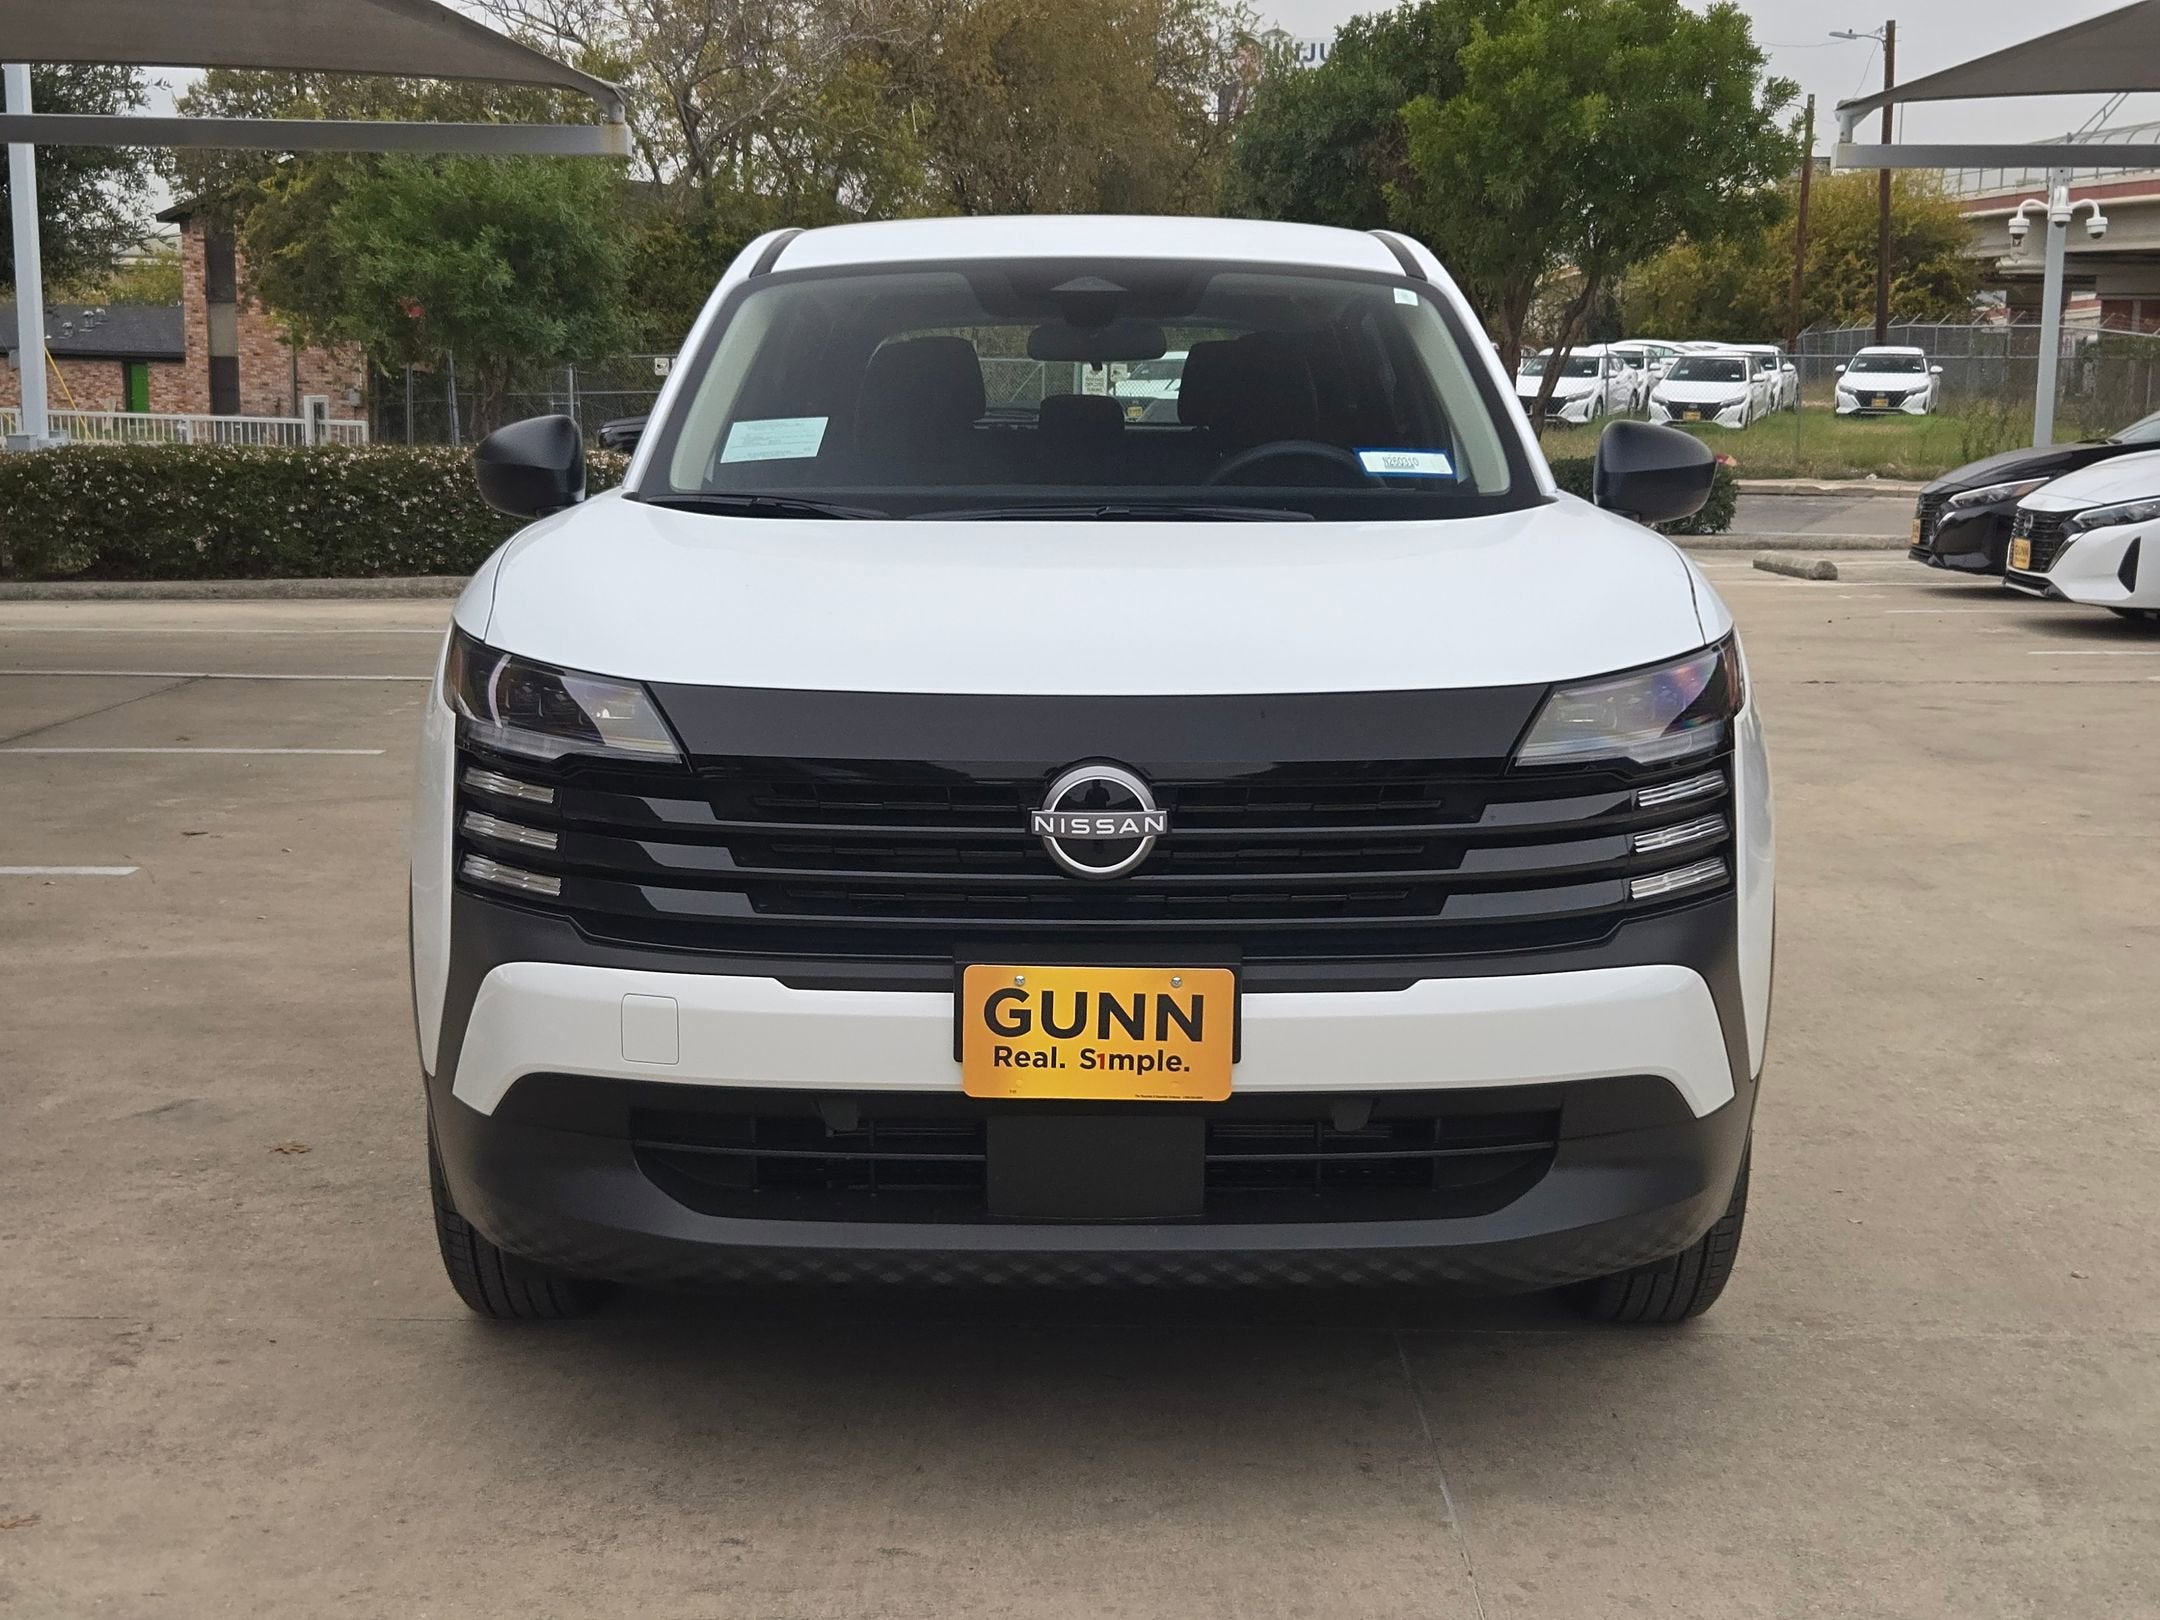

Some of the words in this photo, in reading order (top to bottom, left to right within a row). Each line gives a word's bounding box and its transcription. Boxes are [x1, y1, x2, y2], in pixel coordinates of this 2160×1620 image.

[1034, 815, 1164, 834] NISSAN
[983, 987, 1204, 1042] GUNN
[994, 1045, 1066, 1069] Real.
